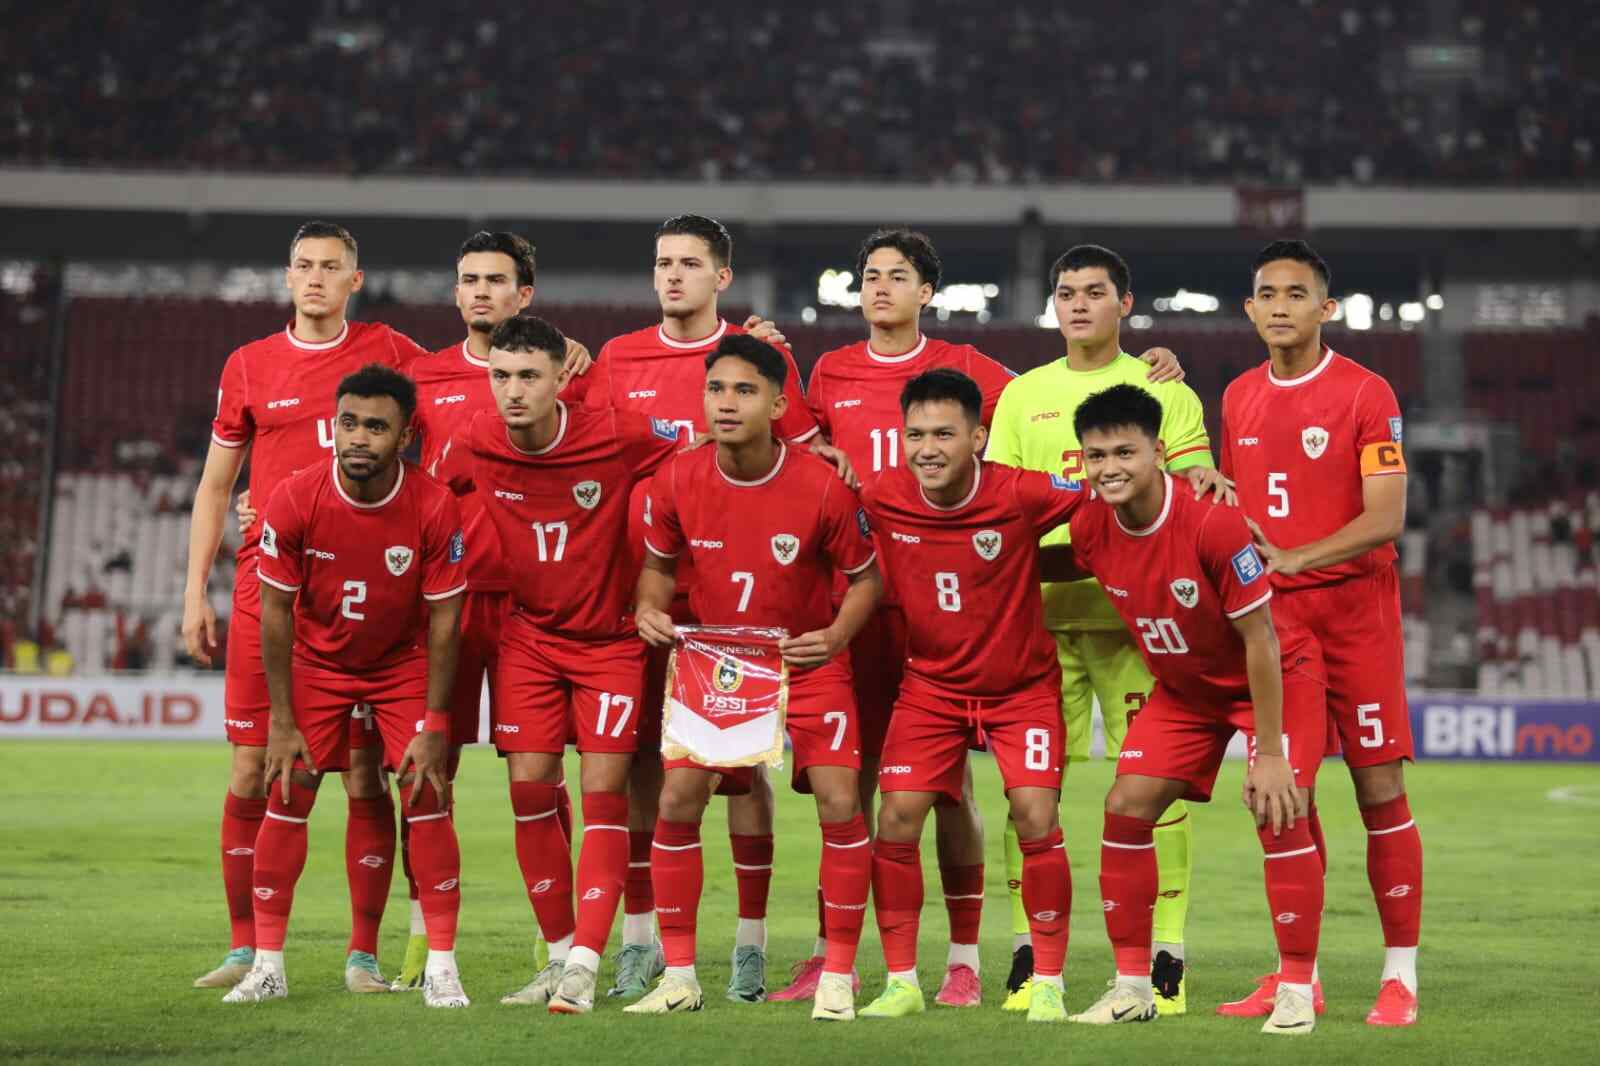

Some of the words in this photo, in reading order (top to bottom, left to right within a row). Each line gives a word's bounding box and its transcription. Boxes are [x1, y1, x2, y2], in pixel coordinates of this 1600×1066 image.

[869, 427, 898, 472] 11
[1377, 445, 1400, 466] C
[1267, 472, 1290, 518] 5
[532, 520, 569, 562] 17
[341, 580, 367, 621] 2
[731, 571, 755, 612] 7
[935, 571, 962, 613] 8
[1135, 617, 1190, 654] 20
[0, 691, 203, 725] UDA.ID
[595, 692, 634, 738] 17
[703, 694, 747, 714] PSSI
[1357, 702, 1384, 748] 5
[823, 711, 848, 751] 7
[1024, 727, 1050, 772] 8
[1423, 704, 1593, 756] BRImo
